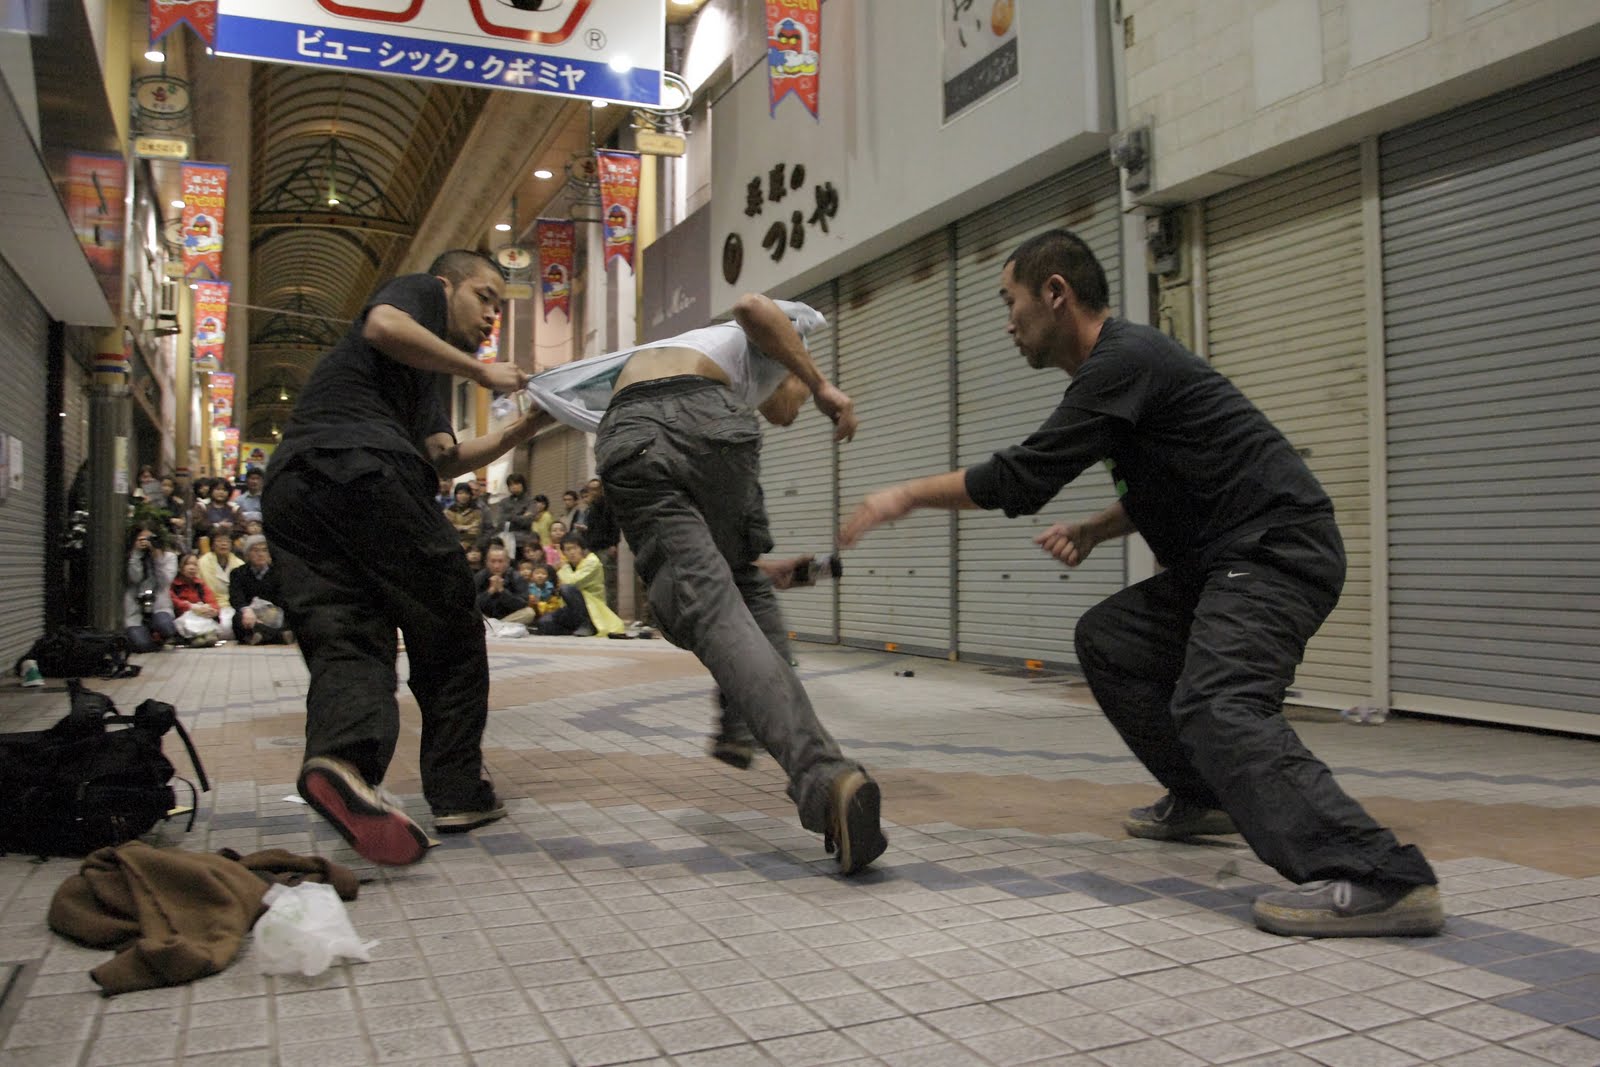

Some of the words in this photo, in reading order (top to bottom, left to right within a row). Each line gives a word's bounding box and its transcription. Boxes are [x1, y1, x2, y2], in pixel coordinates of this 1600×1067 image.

[296, 29, 586, 91] ビューシック・クギミヤ
[600, 174, 638, 185] ストリート
[184, 184, 225, 196] ストリート
